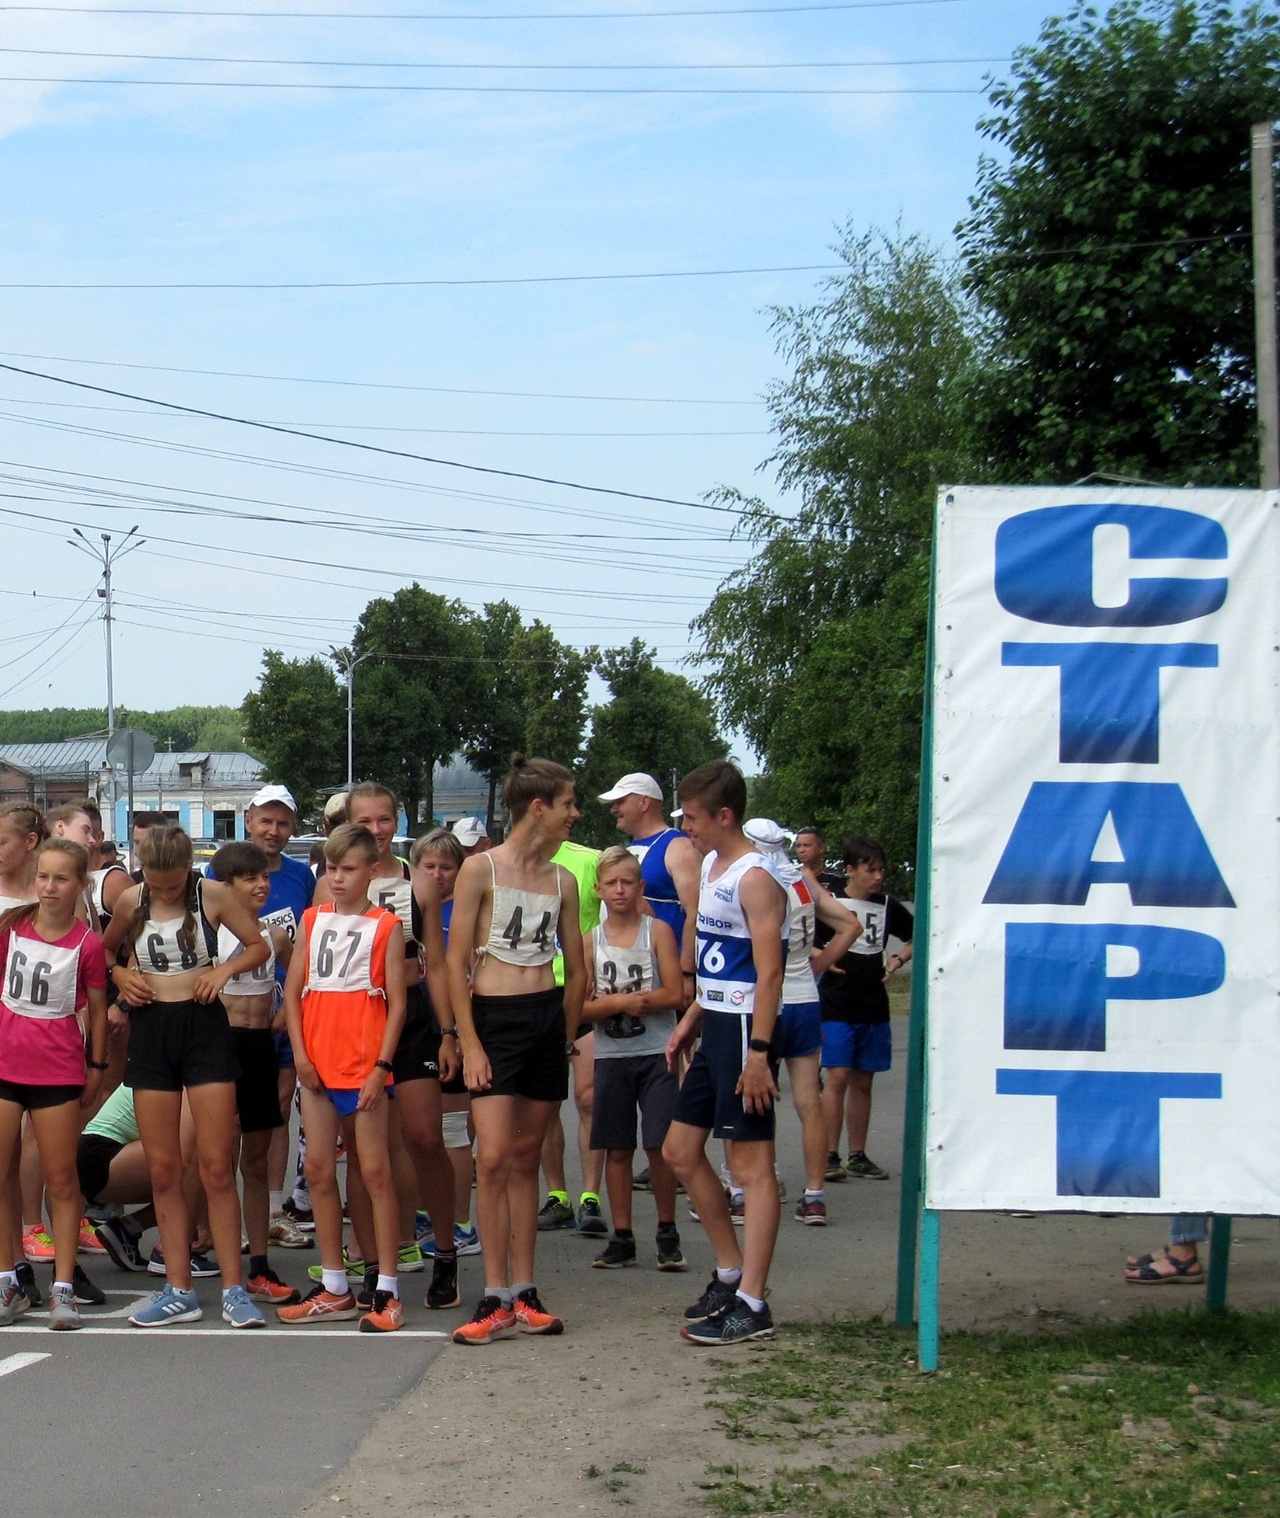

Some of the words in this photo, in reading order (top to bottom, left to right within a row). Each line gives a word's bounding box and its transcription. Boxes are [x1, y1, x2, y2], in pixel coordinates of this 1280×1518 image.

[982, 503, 1237, 1198] СТАРТ
[147, 929, 198, 972] 68
[503, 905, 551, 951] 44
[317, 930, 362, 977] 67
[9, 951, 52, 1006] 66
